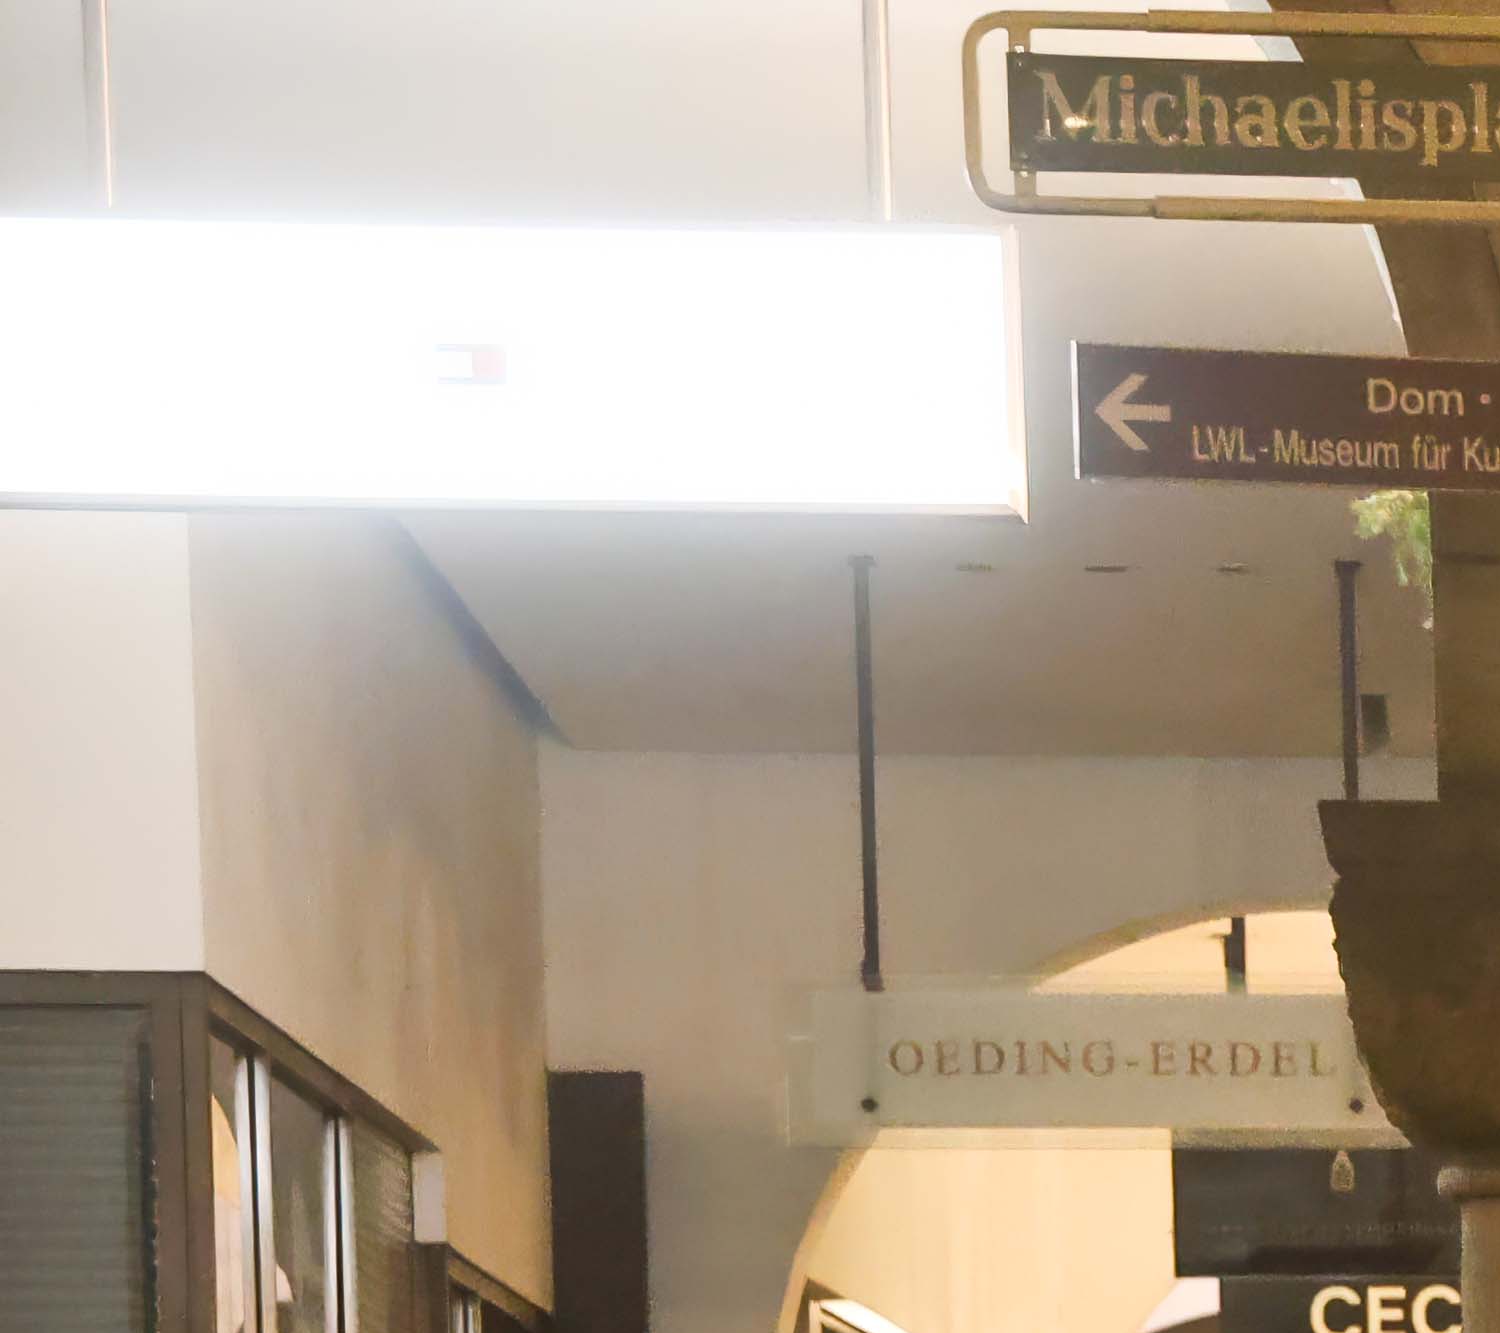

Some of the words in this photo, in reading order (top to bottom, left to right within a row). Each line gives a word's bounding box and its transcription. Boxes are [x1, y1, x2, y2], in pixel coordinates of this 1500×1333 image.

[1366, 377, 1464, 417] Dom
[1192, 425, 1401, 469] LWL-Museum
[1412, 433, 1451, 472] für
[887, 1039, 1337, 1077] OEDING-ERDEL
